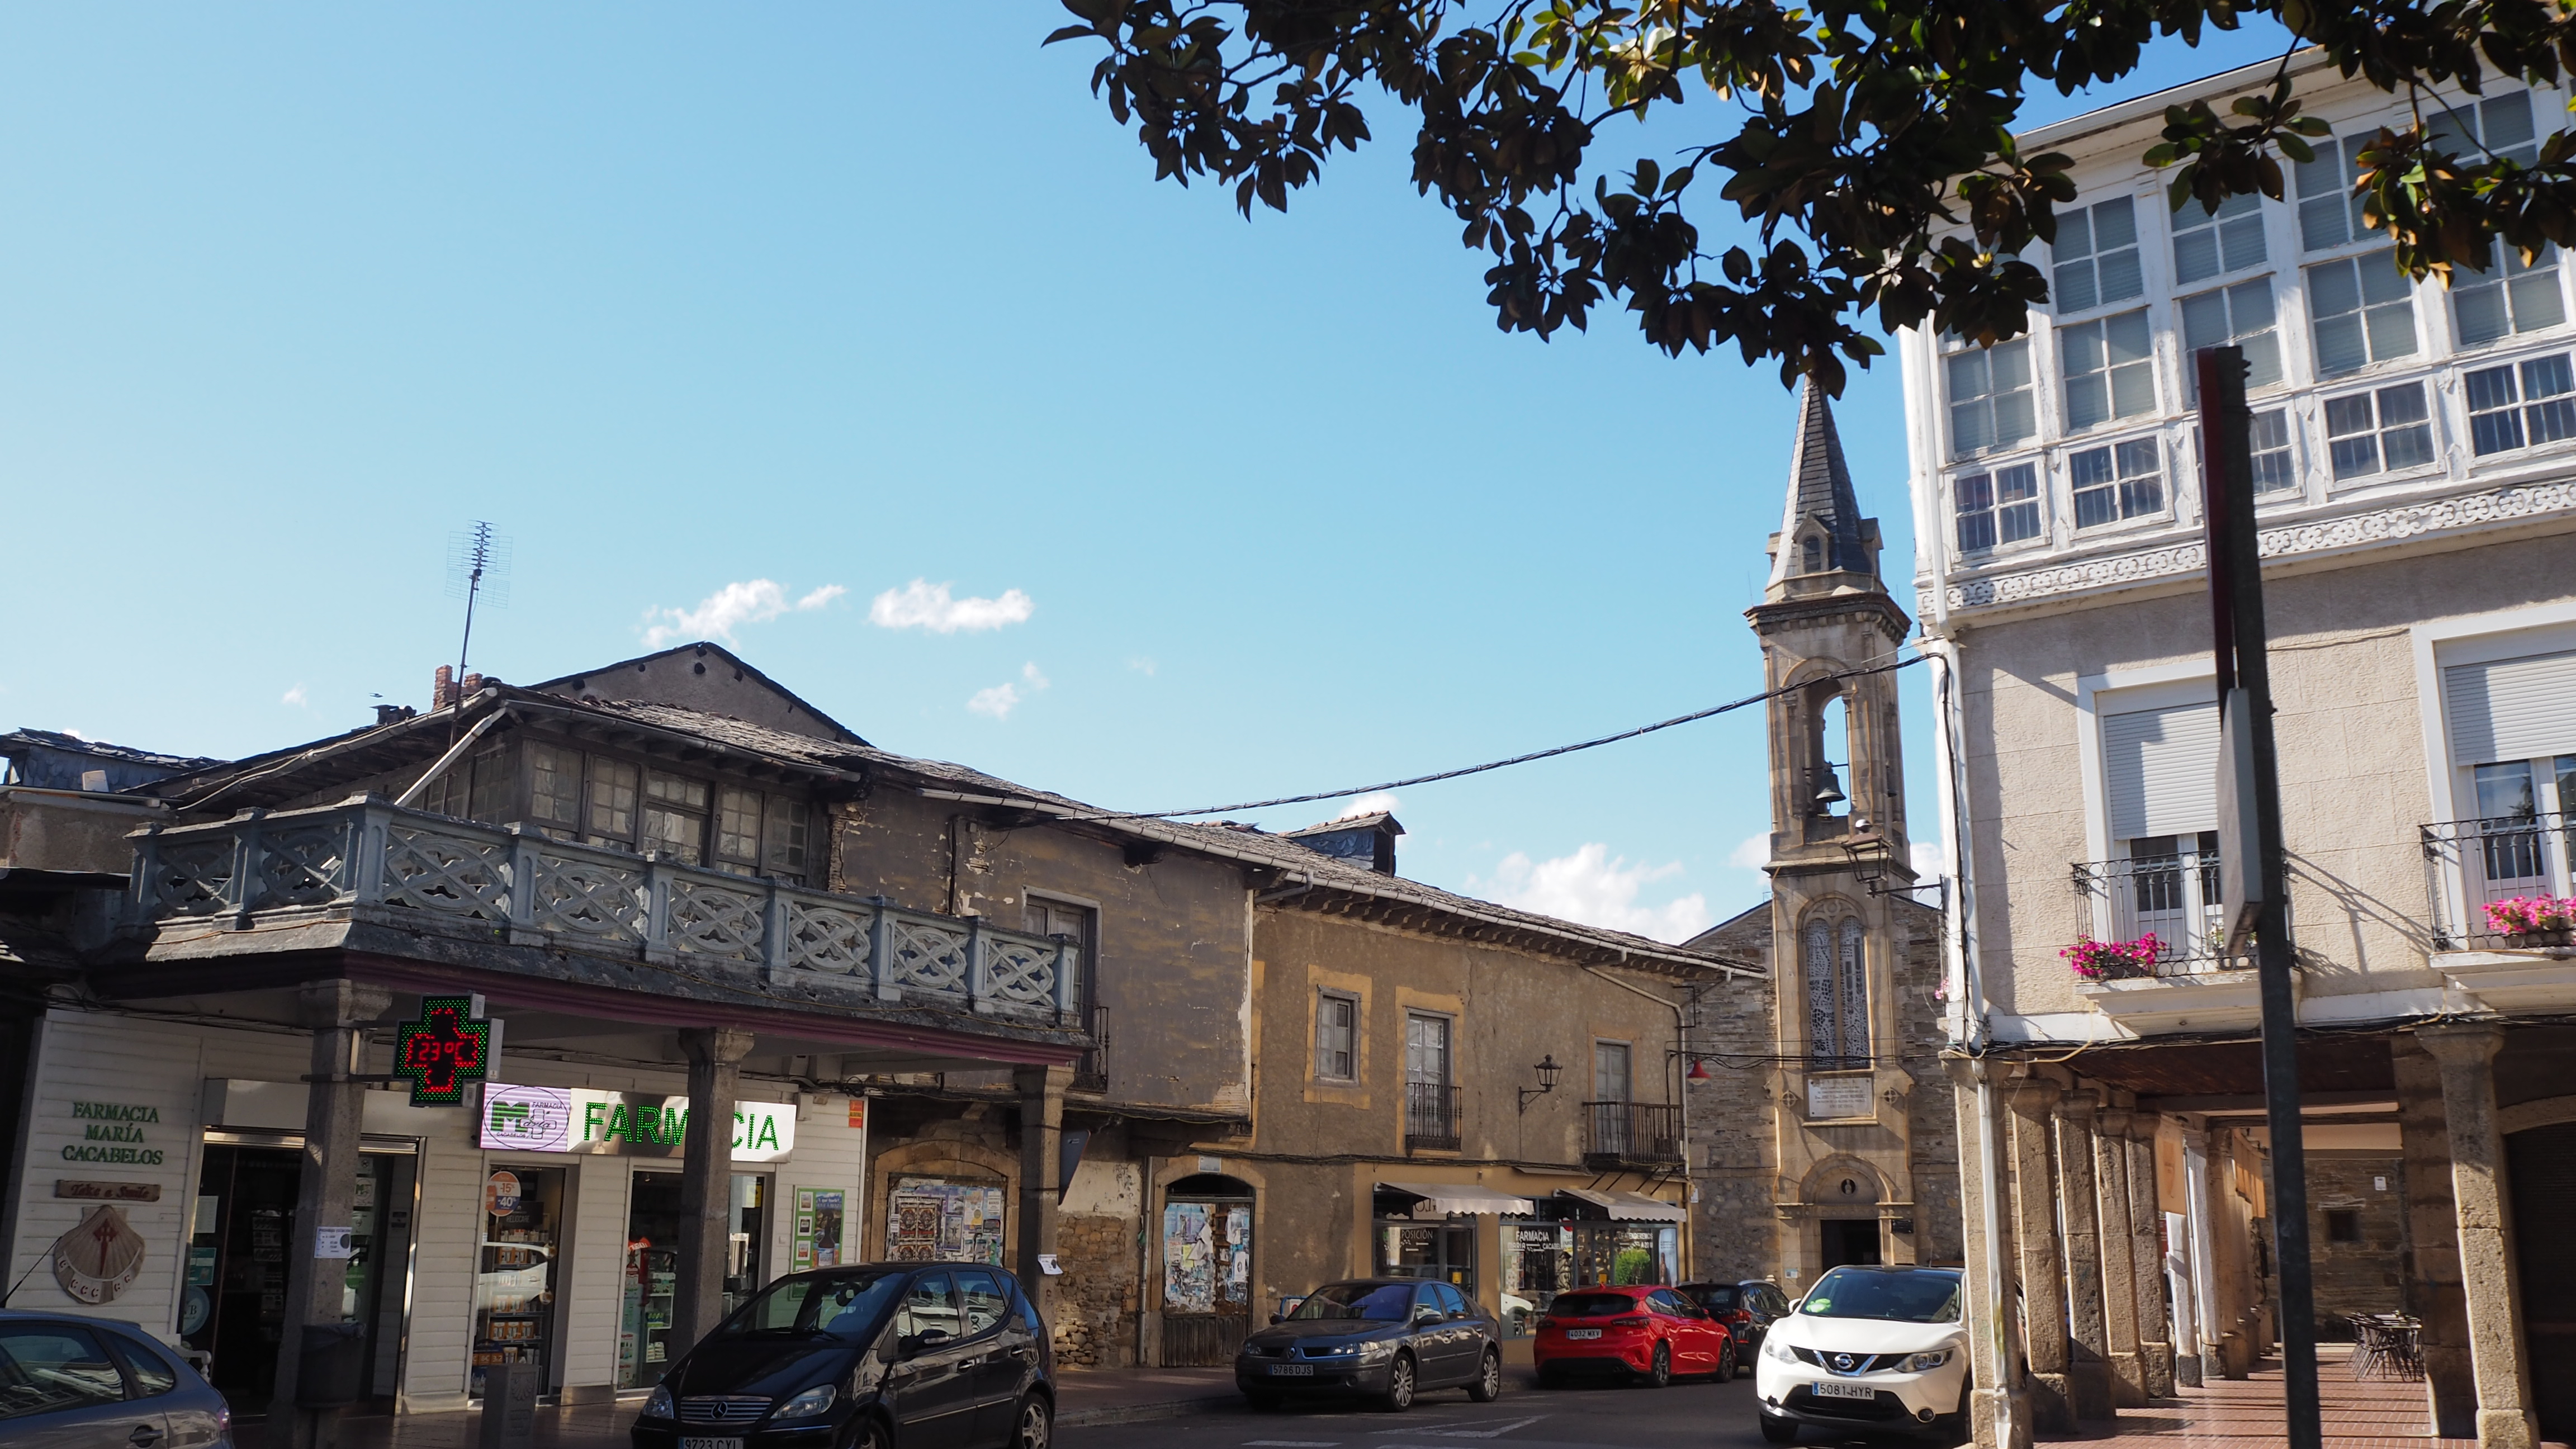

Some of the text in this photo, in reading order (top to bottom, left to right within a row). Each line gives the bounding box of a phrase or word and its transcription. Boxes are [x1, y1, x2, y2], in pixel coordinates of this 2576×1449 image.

[72, 1102, 160, 1123] FARMACIA
[85, 1123, 144, 1143] MARÍA
[584, 1102, 779, 1150] FARMCIA
[62, 1145, 163, 1165] CACABELOS
[1391, 1229, 1433, 1239] POSICIÓN
[1516, 1231, 1550, 1242] FARMACIA
[1273, 1365, 1311, 1375] 5786 DJS
[1820, 1384, 1872, 1398] 5081 HYR
[685, 1439, 713, 1449] 9723
